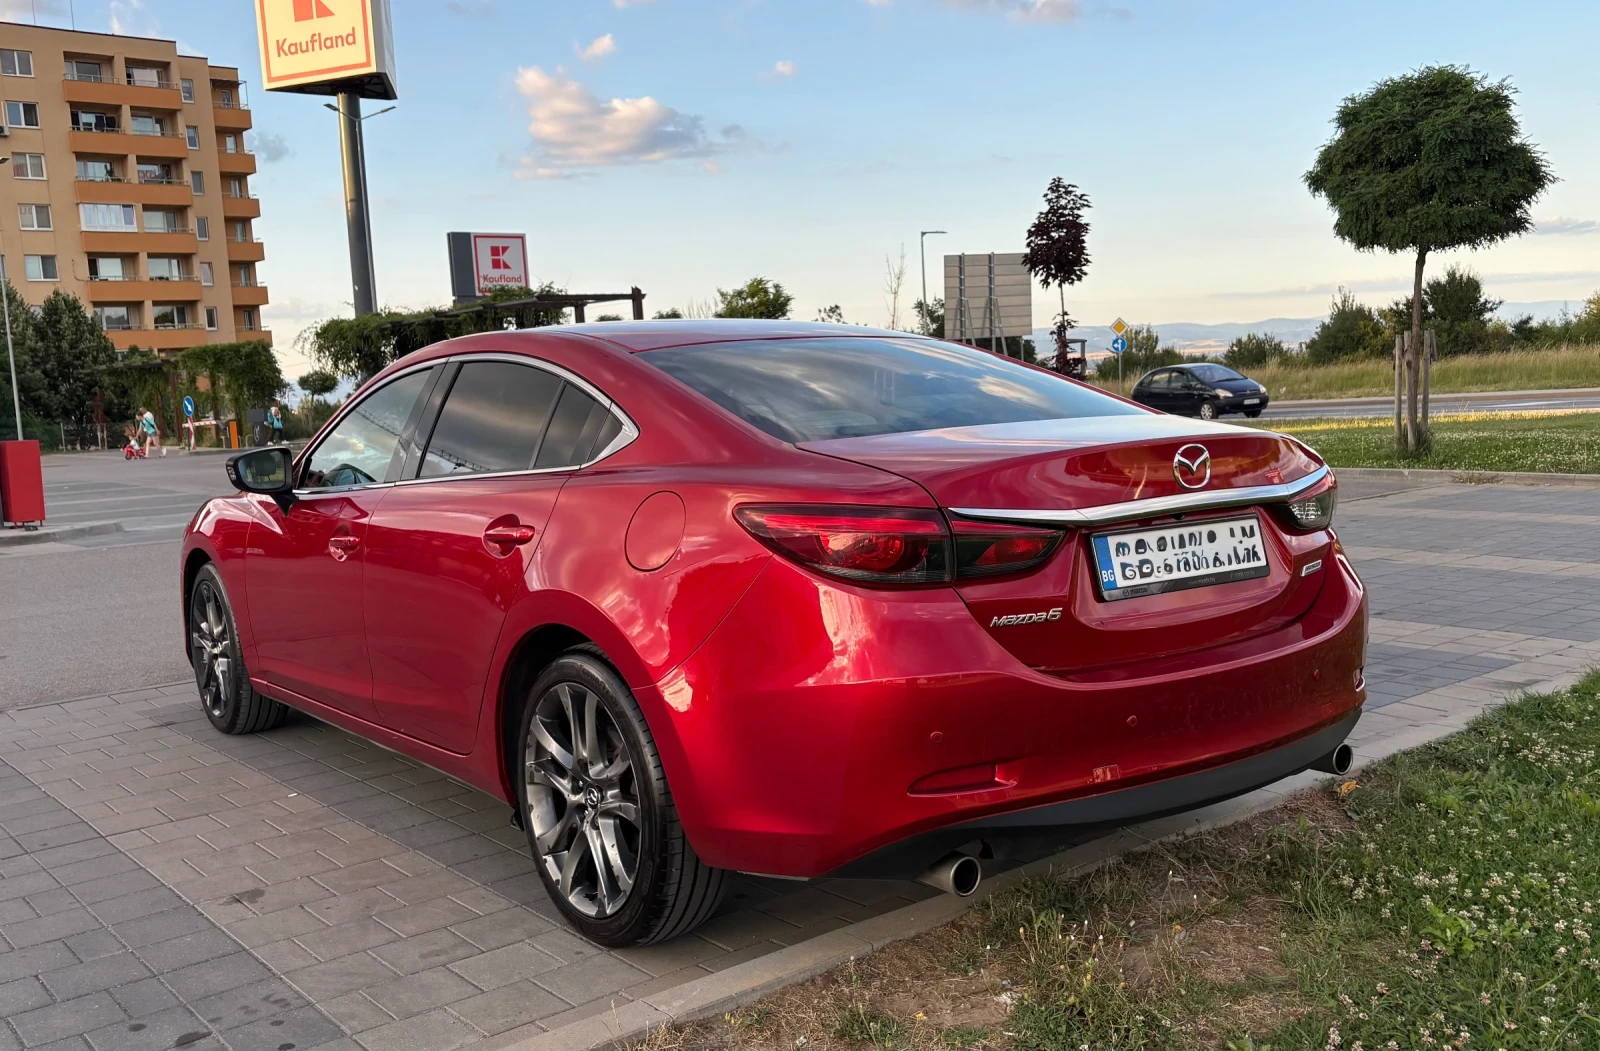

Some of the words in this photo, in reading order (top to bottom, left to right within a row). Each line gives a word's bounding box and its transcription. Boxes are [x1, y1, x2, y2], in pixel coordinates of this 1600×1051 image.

[276, 26, 356, 58] Kaufland
[483, 274, 522, 283] Kaufland
[1101, 569, 1115, 583] BG
